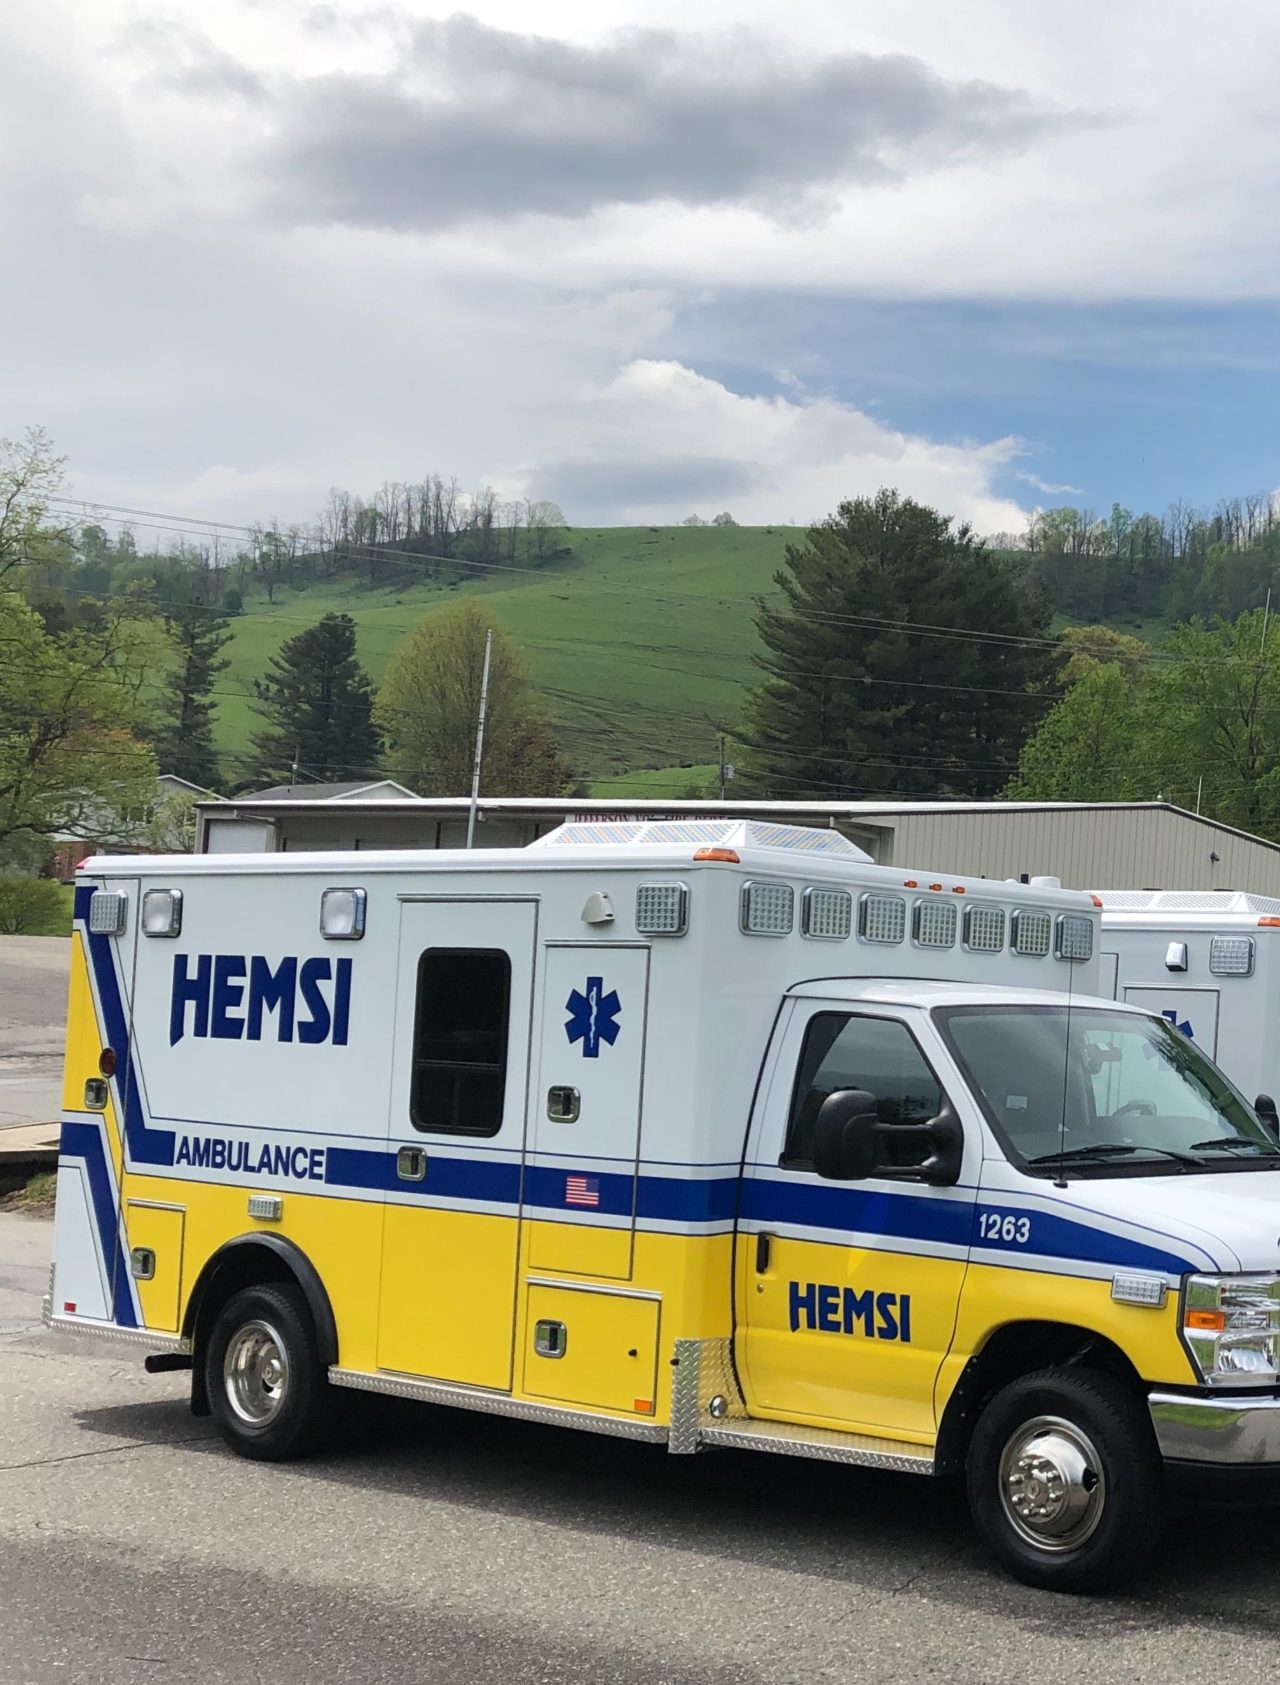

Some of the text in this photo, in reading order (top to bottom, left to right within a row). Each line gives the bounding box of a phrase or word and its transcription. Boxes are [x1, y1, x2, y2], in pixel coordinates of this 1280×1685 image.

[170, 953, 353, 1047] HEMSI
[176, 1135, 326, 1181] AMBULANCE
[979, 1213, 1031, 1243] 1263
[789, 1281, 911, 1343] HEMSI
